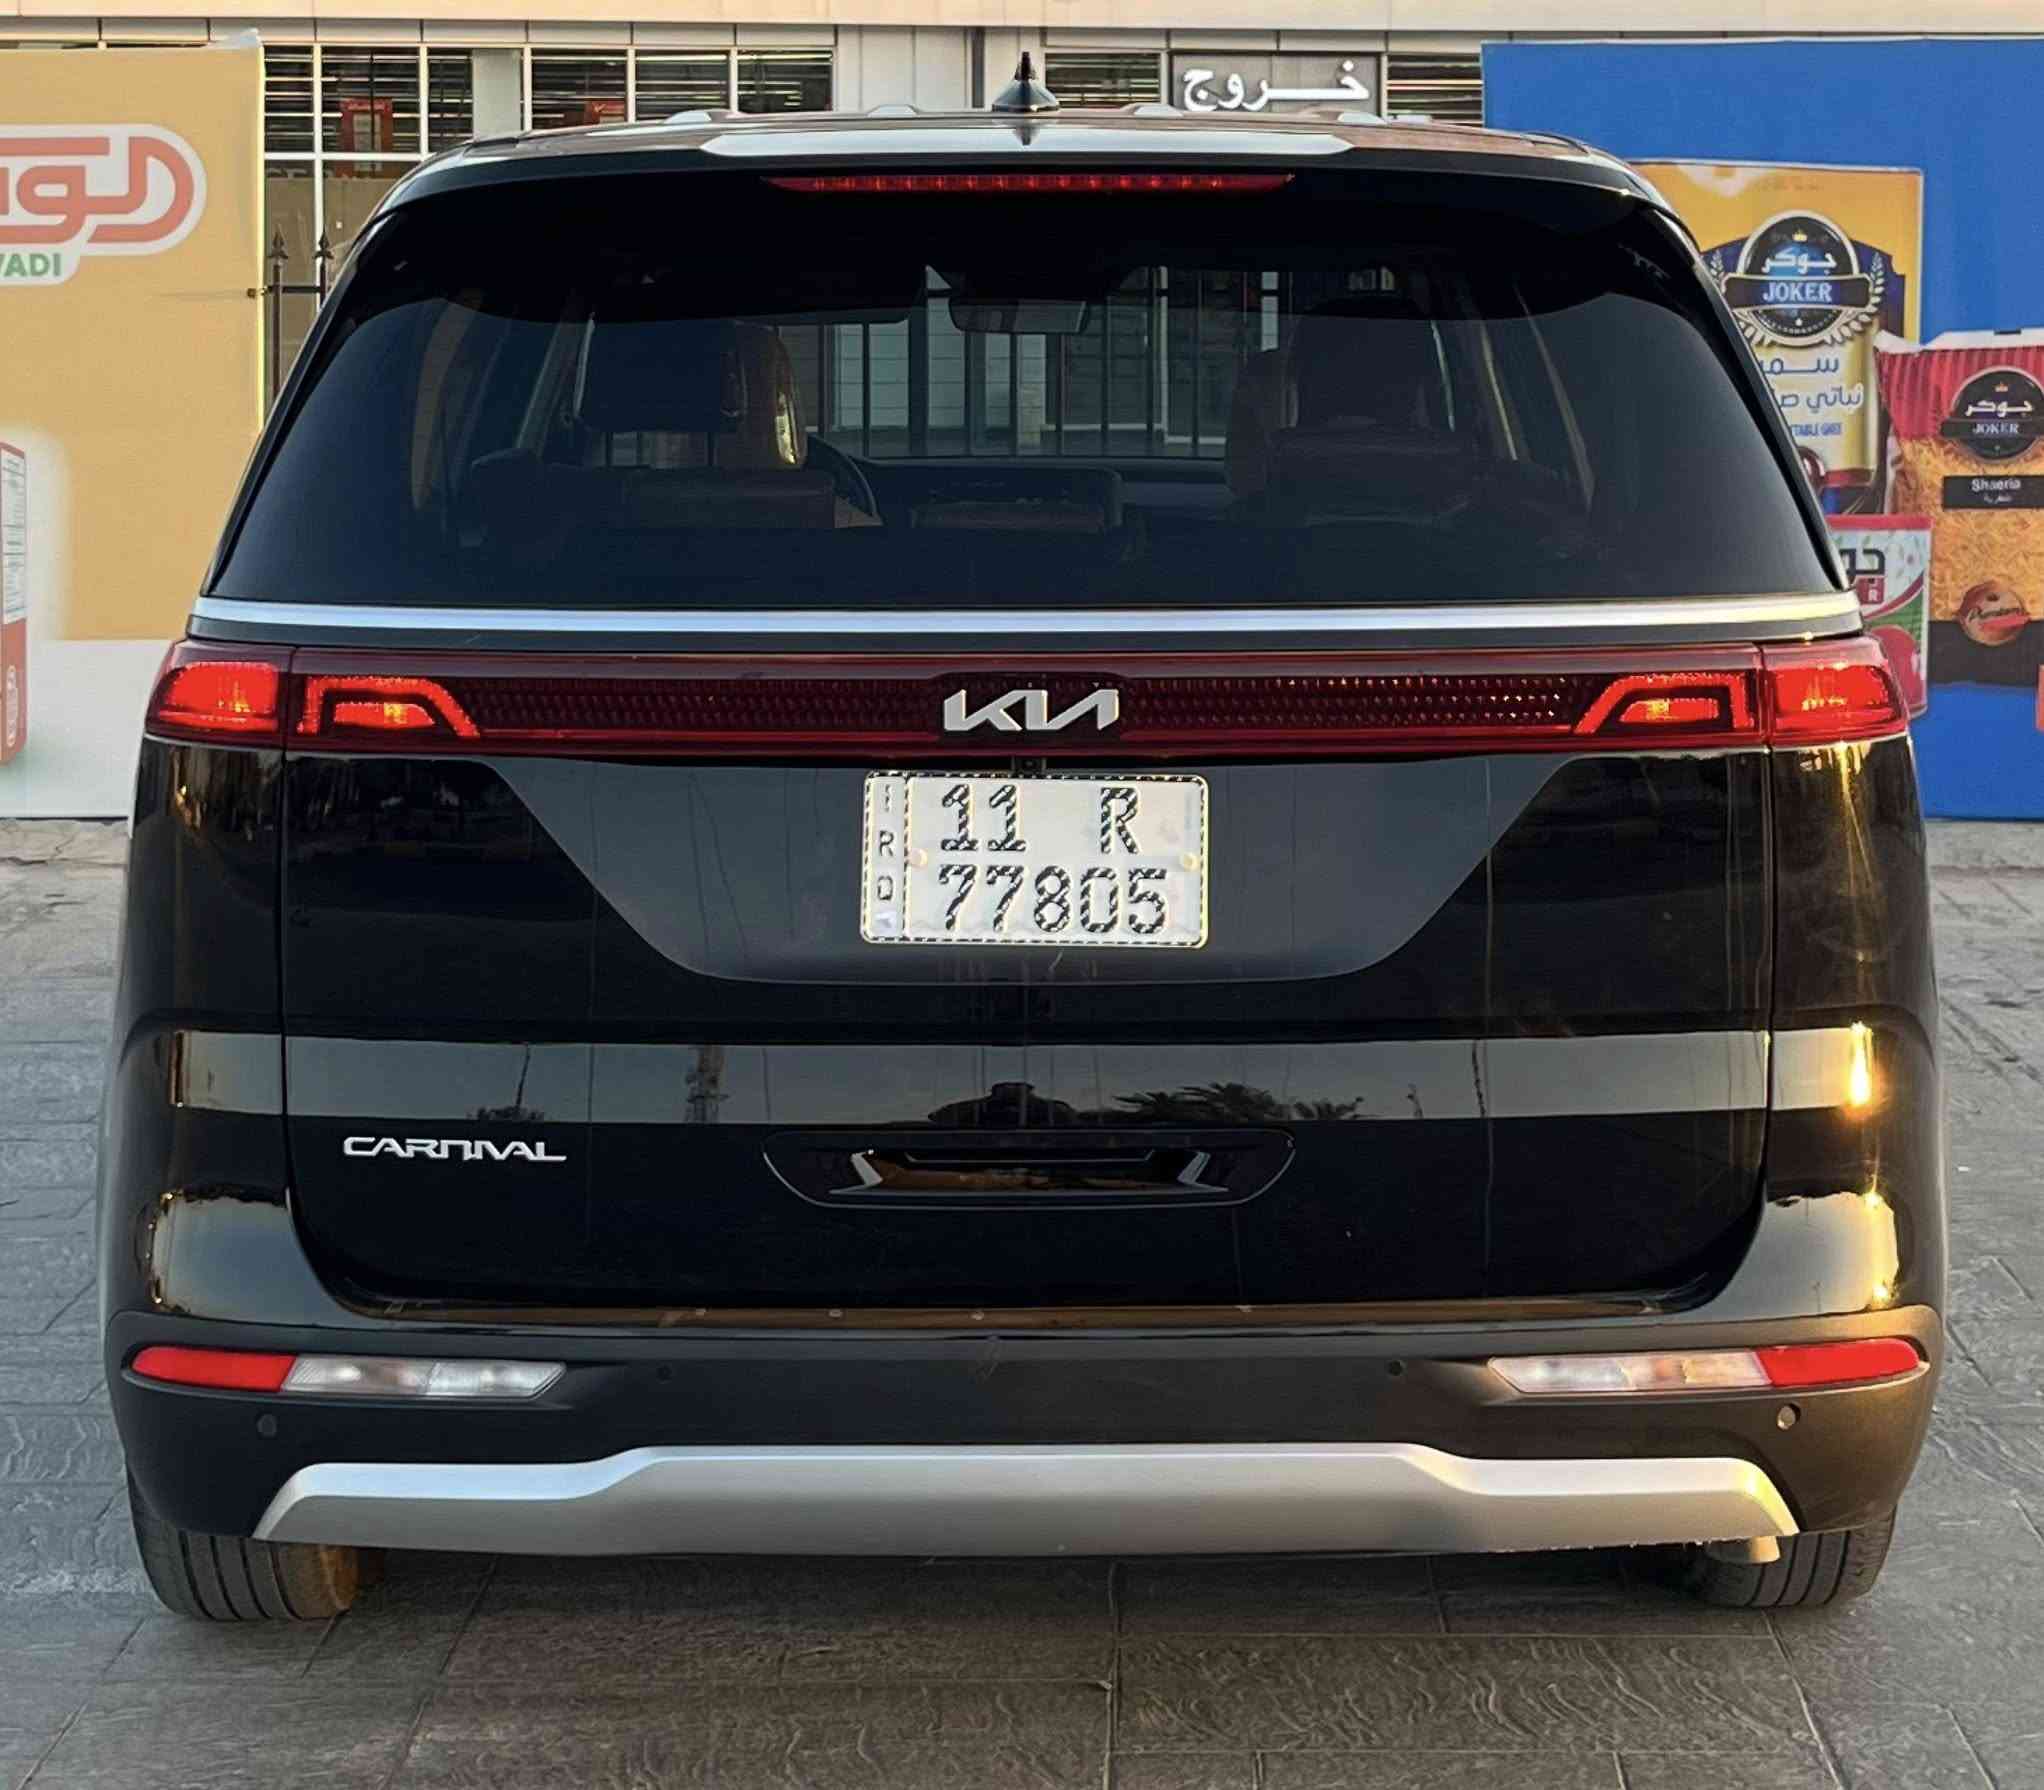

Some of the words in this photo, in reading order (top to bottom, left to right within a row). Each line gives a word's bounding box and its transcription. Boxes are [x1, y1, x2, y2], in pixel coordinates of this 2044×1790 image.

[1183, 60, 1370, 112] خروج
[1761, 250, 1837, 275] جوكر
[1763, 282, 1833, 303] JOKER
[1965, 400, 2034, 418] جوكر
[1973, 423, 2020, 434] JOKER
[944, 689, 1119, 731] KIA
[941, 783, 1027, 851] 11
[1100, 786, 1141, 854] R
[938, 863, 1167, 934] 77805
[343, 1136, 568, 1161] CARNIVAL
